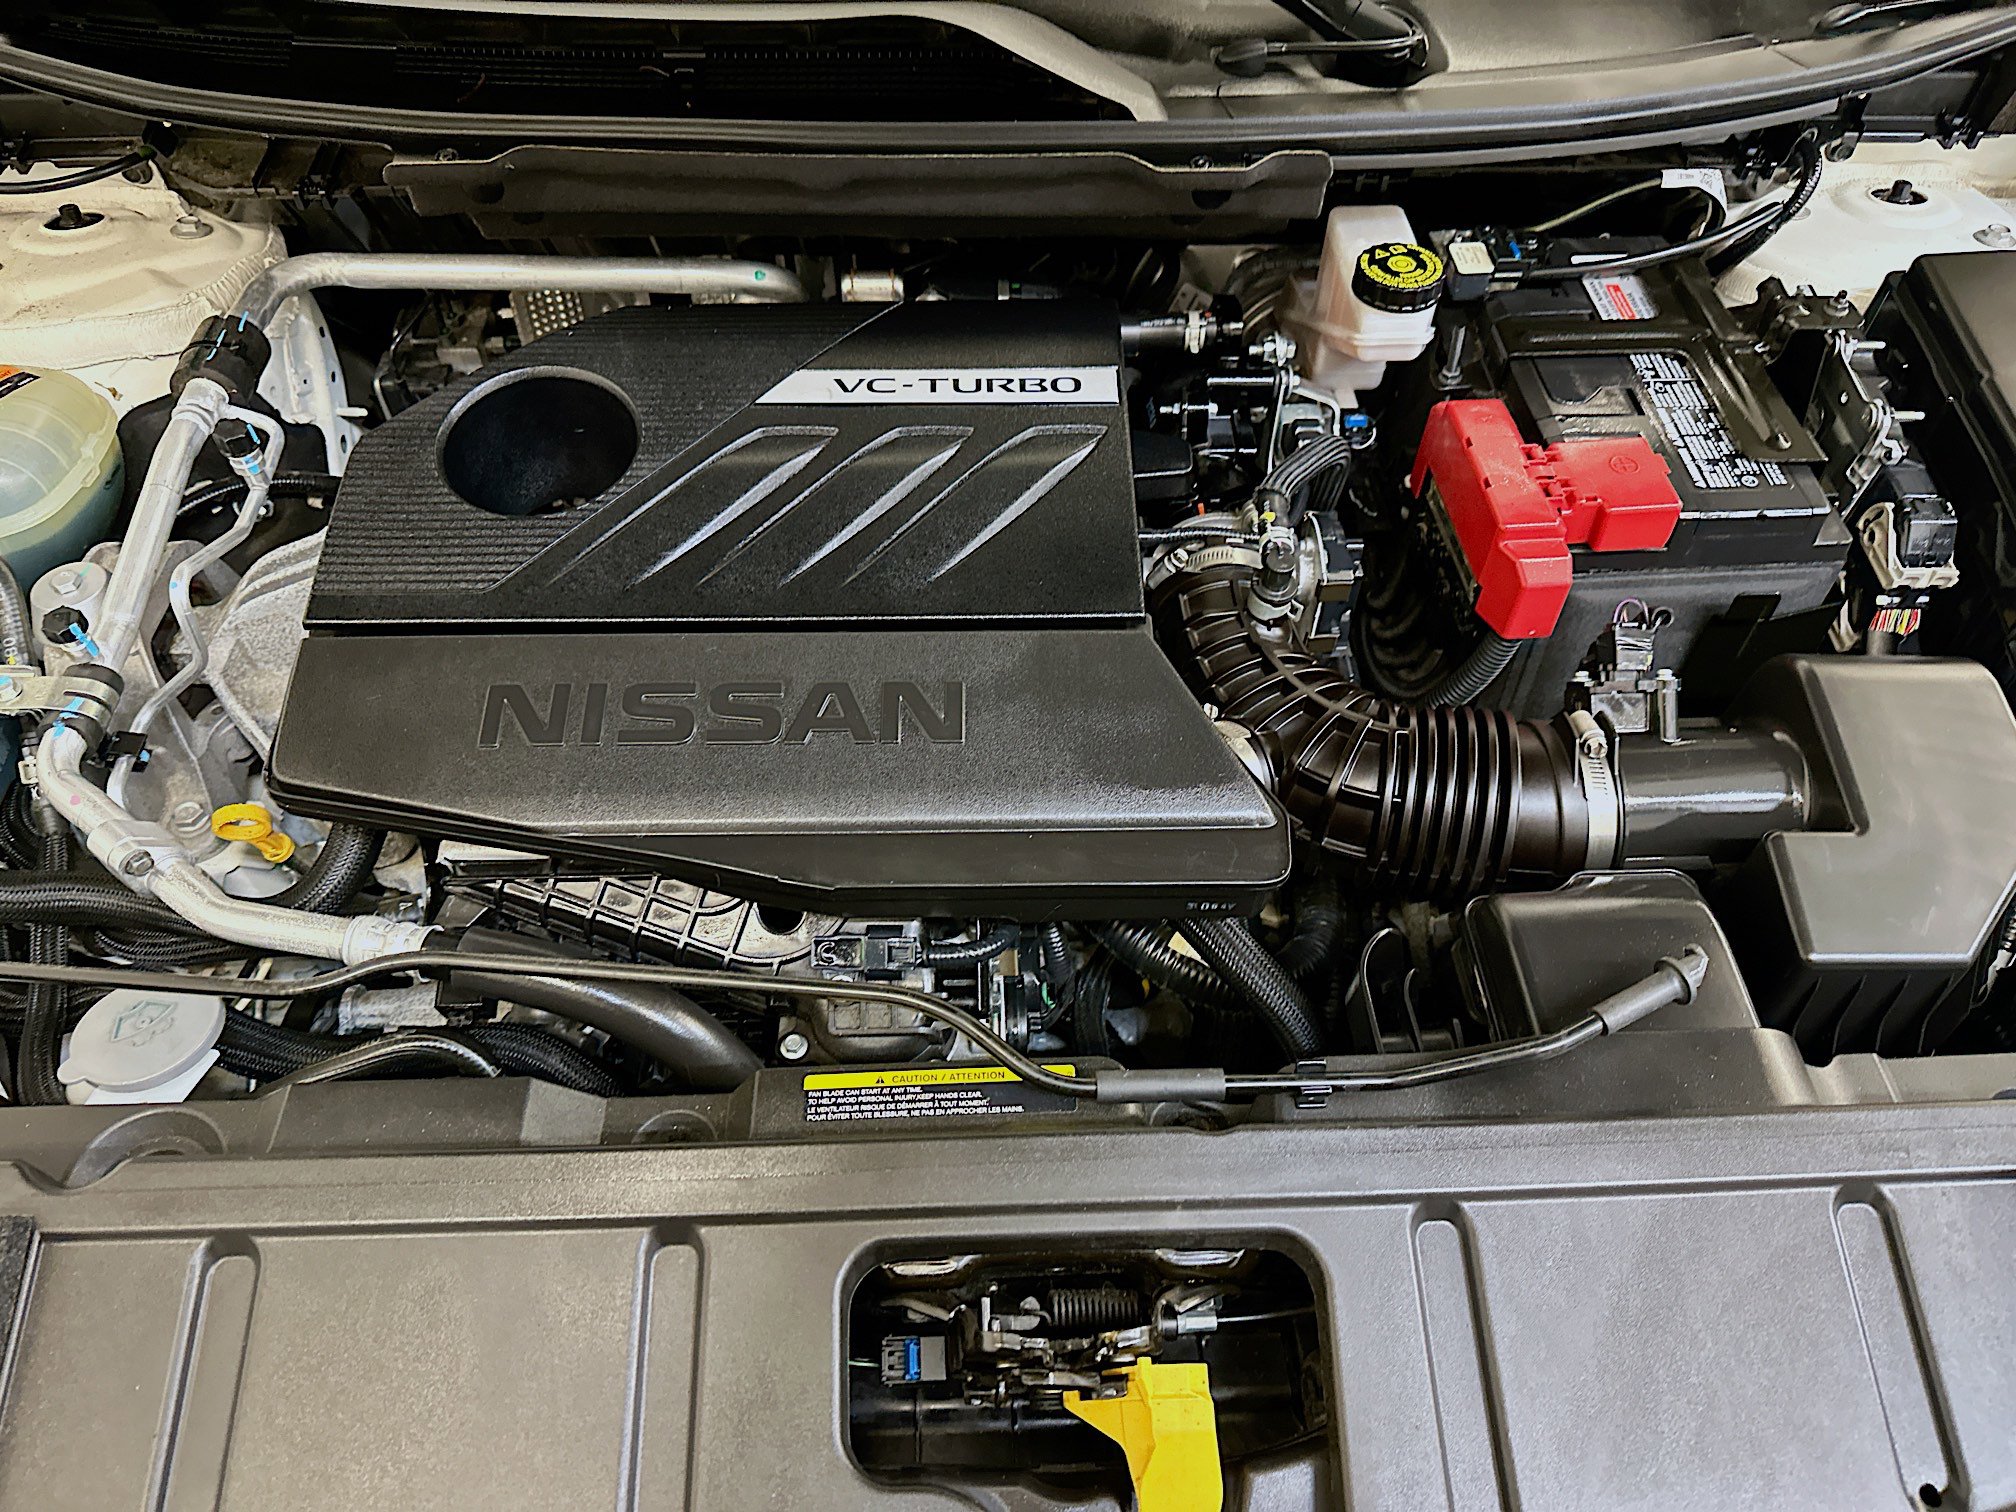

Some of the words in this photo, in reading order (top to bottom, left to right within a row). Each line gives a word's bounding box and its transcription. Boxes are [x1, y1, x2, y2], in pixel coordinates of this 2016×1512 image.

[833, 377, 1082, 394] VC-TURBO
[477, 681, 966, 749] NISSAN
[891, 1073, 938, 1083] CAUTION
[949, 1071, 1005, 1081] ATTENTION
[891, 1086, 905, 1094] ANY
[817, 1104, 860, 1113] VENTILATEUR
[860, 1103, 886, 1111] RISQUE
[886, 1102, 896, 1110] DE
[896, 1100, 933, 1110] DÉMARRER
[934, 1099, 940, 1108] À
[836, 1096, 857, 1104] AVOID
[858, 1095, 893, 1103] PERSONAL
[827, 1112, 850, 1120] ÉVITER
[873, 1110, 910, 1119] BLESSURE,
[945, 1107, 987, 1115] APPROCHER
[1001, 1105, 1025, 1113] MAINS.
